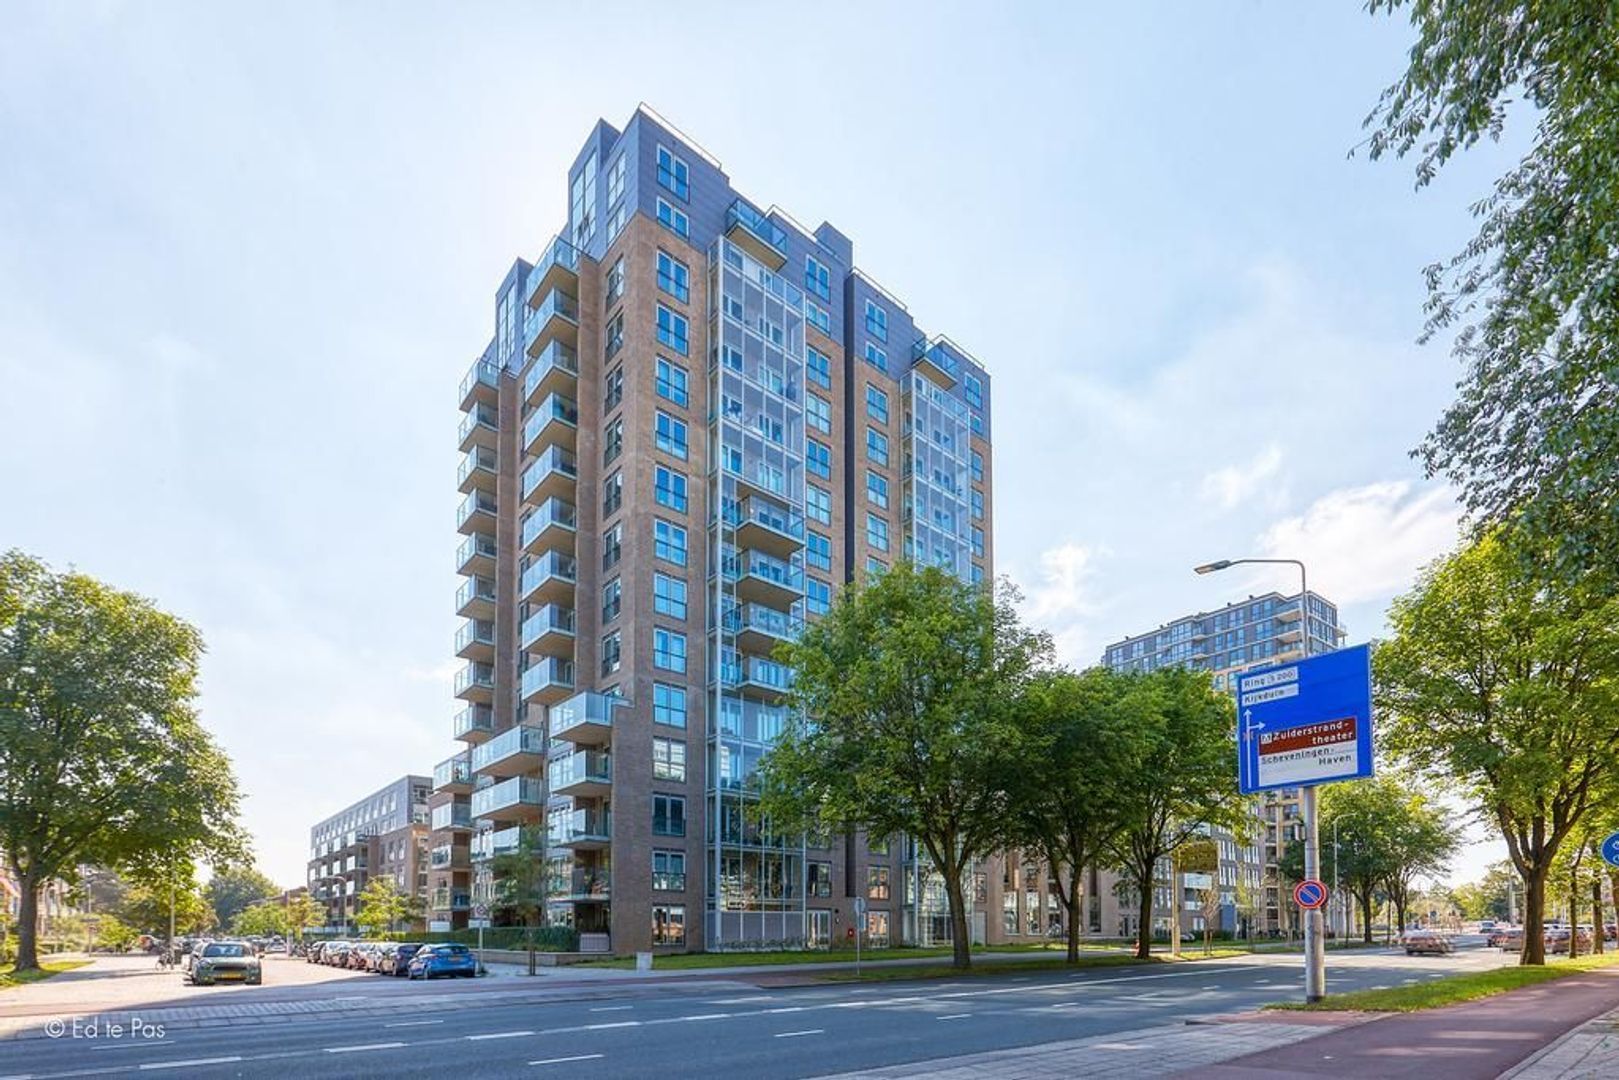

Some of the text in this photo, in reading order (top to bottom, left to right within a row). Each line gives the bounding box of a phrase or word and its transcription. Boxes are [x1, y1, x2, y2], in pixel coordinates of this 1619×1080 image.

[1244, 677, 1265, 689] Ring
[1273, 721, 1349, 741] Zuiderstrand-
[1312, 732, 1353, 745] theater
[1261, 747, 1335, 765] Scheveningen-
[1319, 755, 1352, 765] Haven
